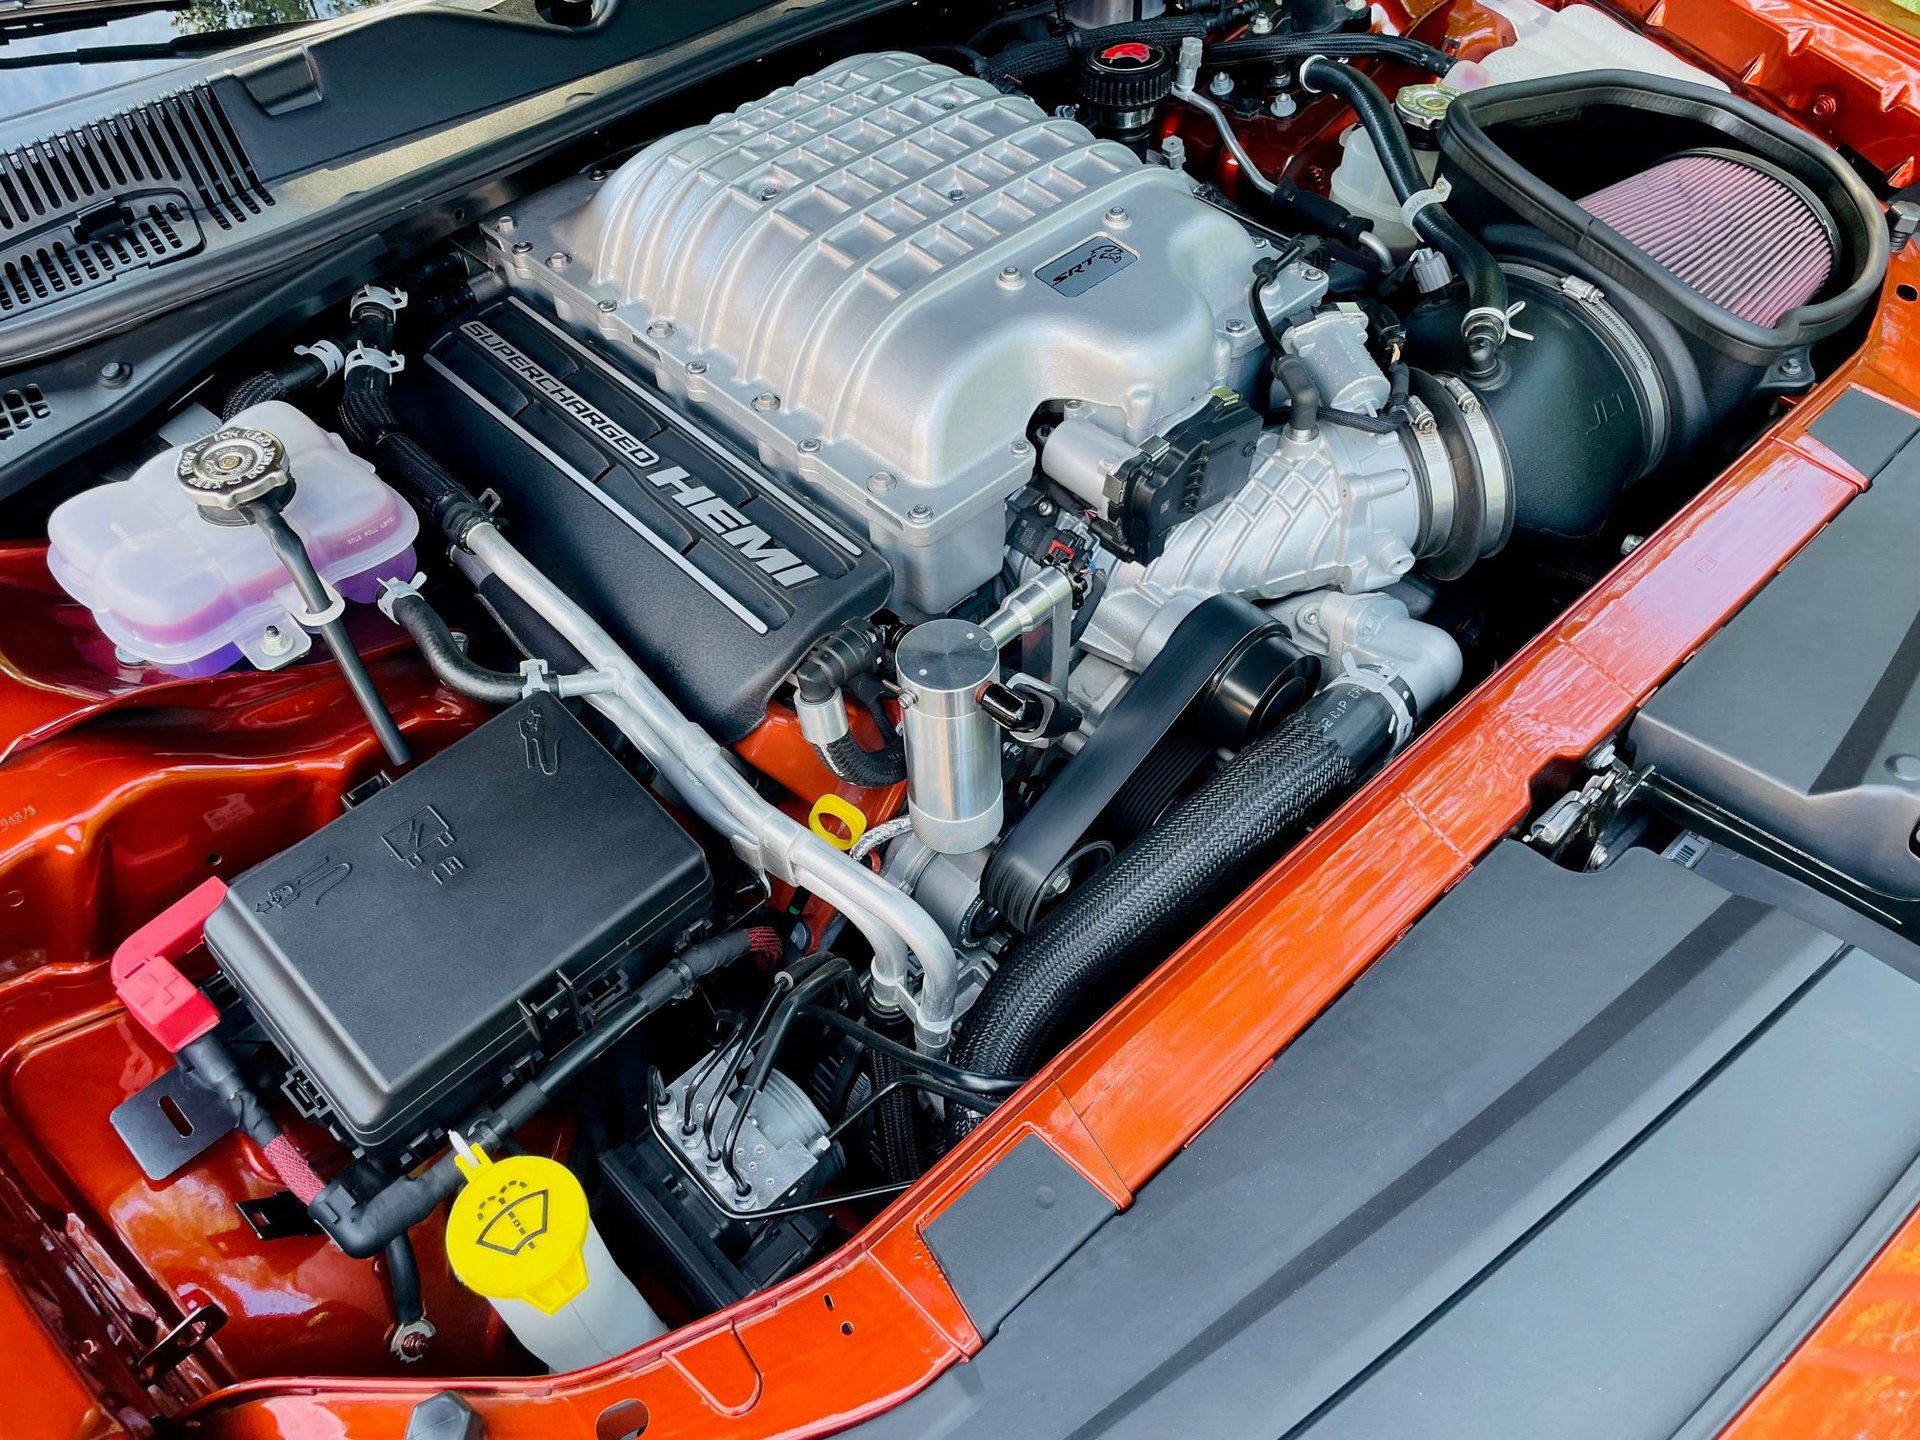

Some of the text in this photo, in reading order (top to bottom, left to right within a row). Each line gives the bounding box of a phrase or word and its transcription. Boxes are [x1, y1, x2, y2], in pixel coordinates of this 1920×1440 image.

[1052, 255, 1096, 286] SRT
[462, 322, 658, 467] SUPERCHARGED
[646, 466, 820, 588] HEMI
